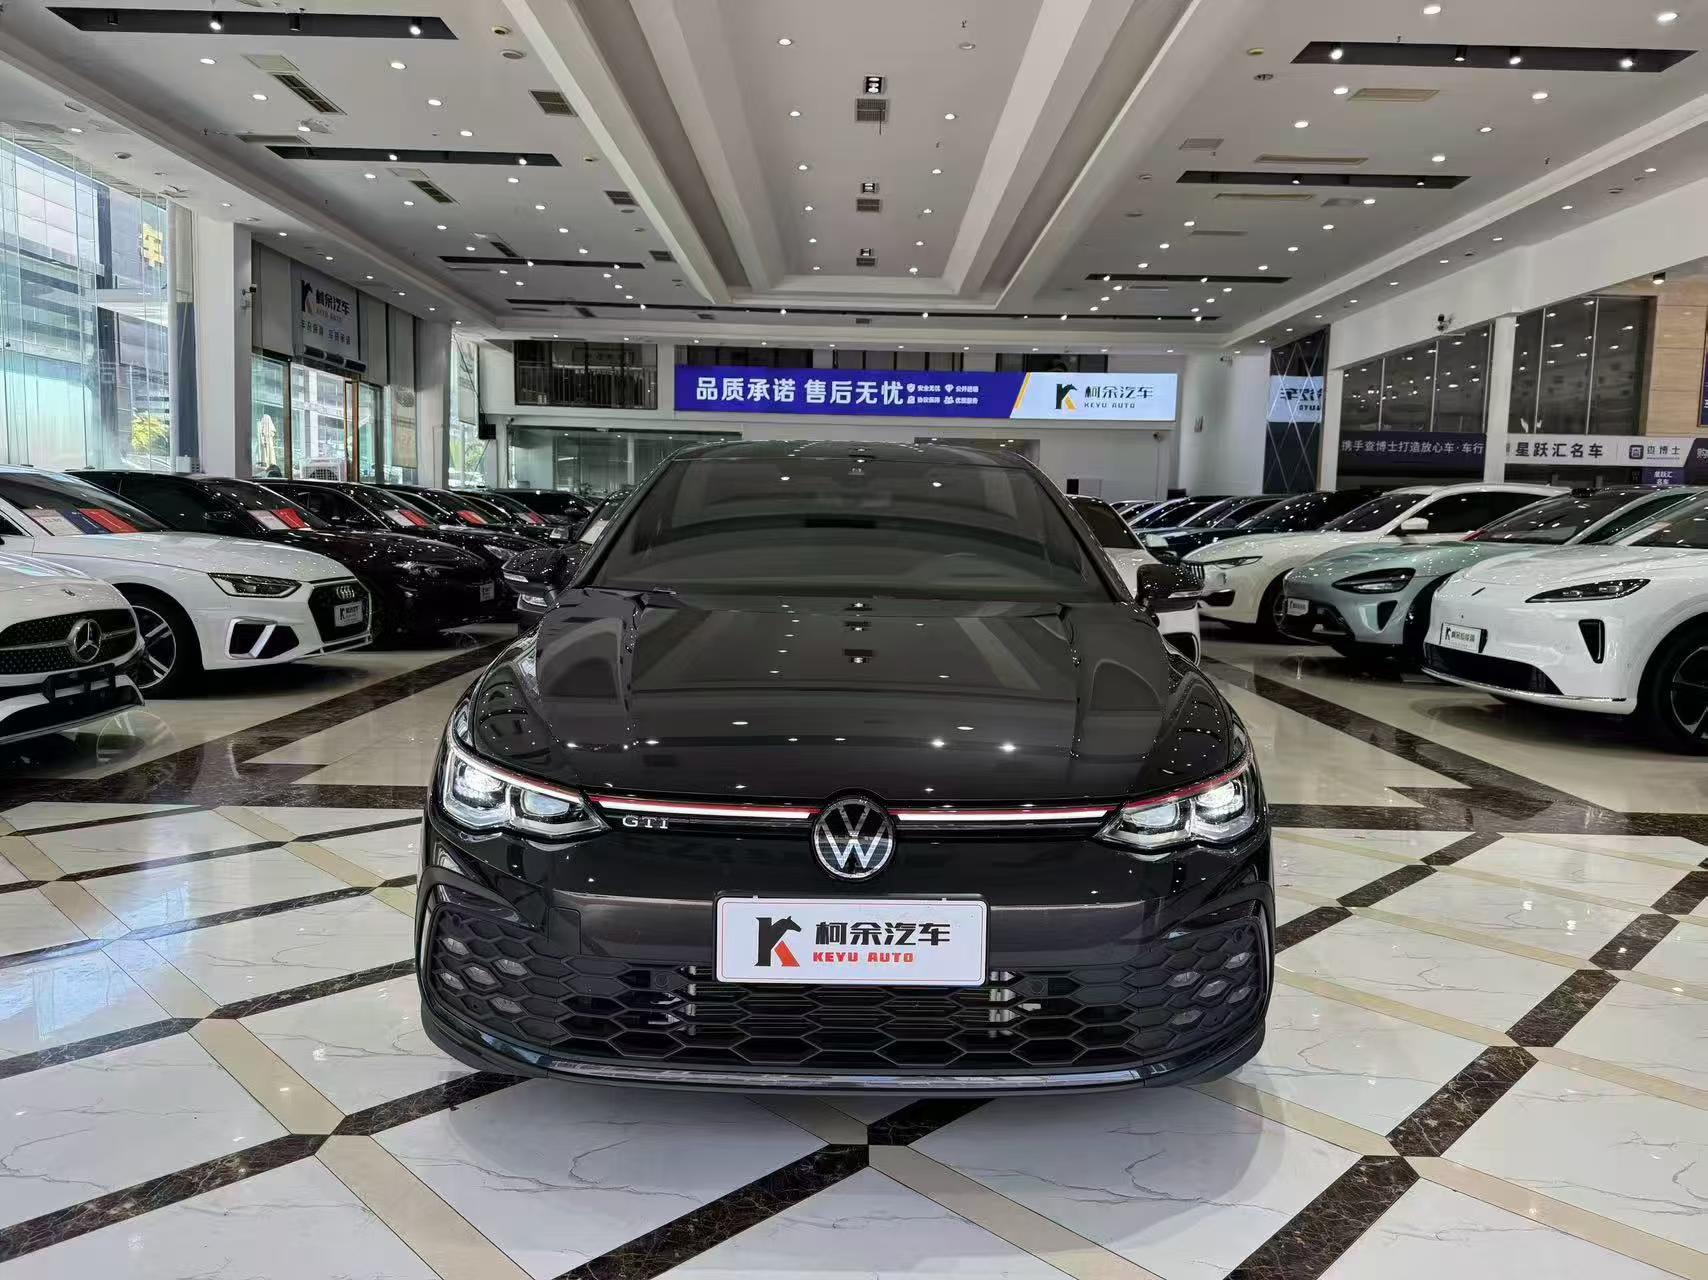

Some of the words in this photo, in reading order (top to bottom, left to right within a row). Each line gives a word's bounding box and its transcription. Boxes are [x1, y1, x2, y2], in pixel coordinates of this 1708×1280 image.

[696, 377, 796, 402] 品质承诺
[804, 379, 904, 405] 售后无忧
[1084, 385, 1153, 399] 柯余汽车
[1515, 442, 1603, 459] 星跃汇名车
[622, 815, 669, 829] GTI
[815, 921, 951, 946] 柯余汽车
[812, 951, 859, 963] KEYU
[867, 952, 915, 963] AUTO
